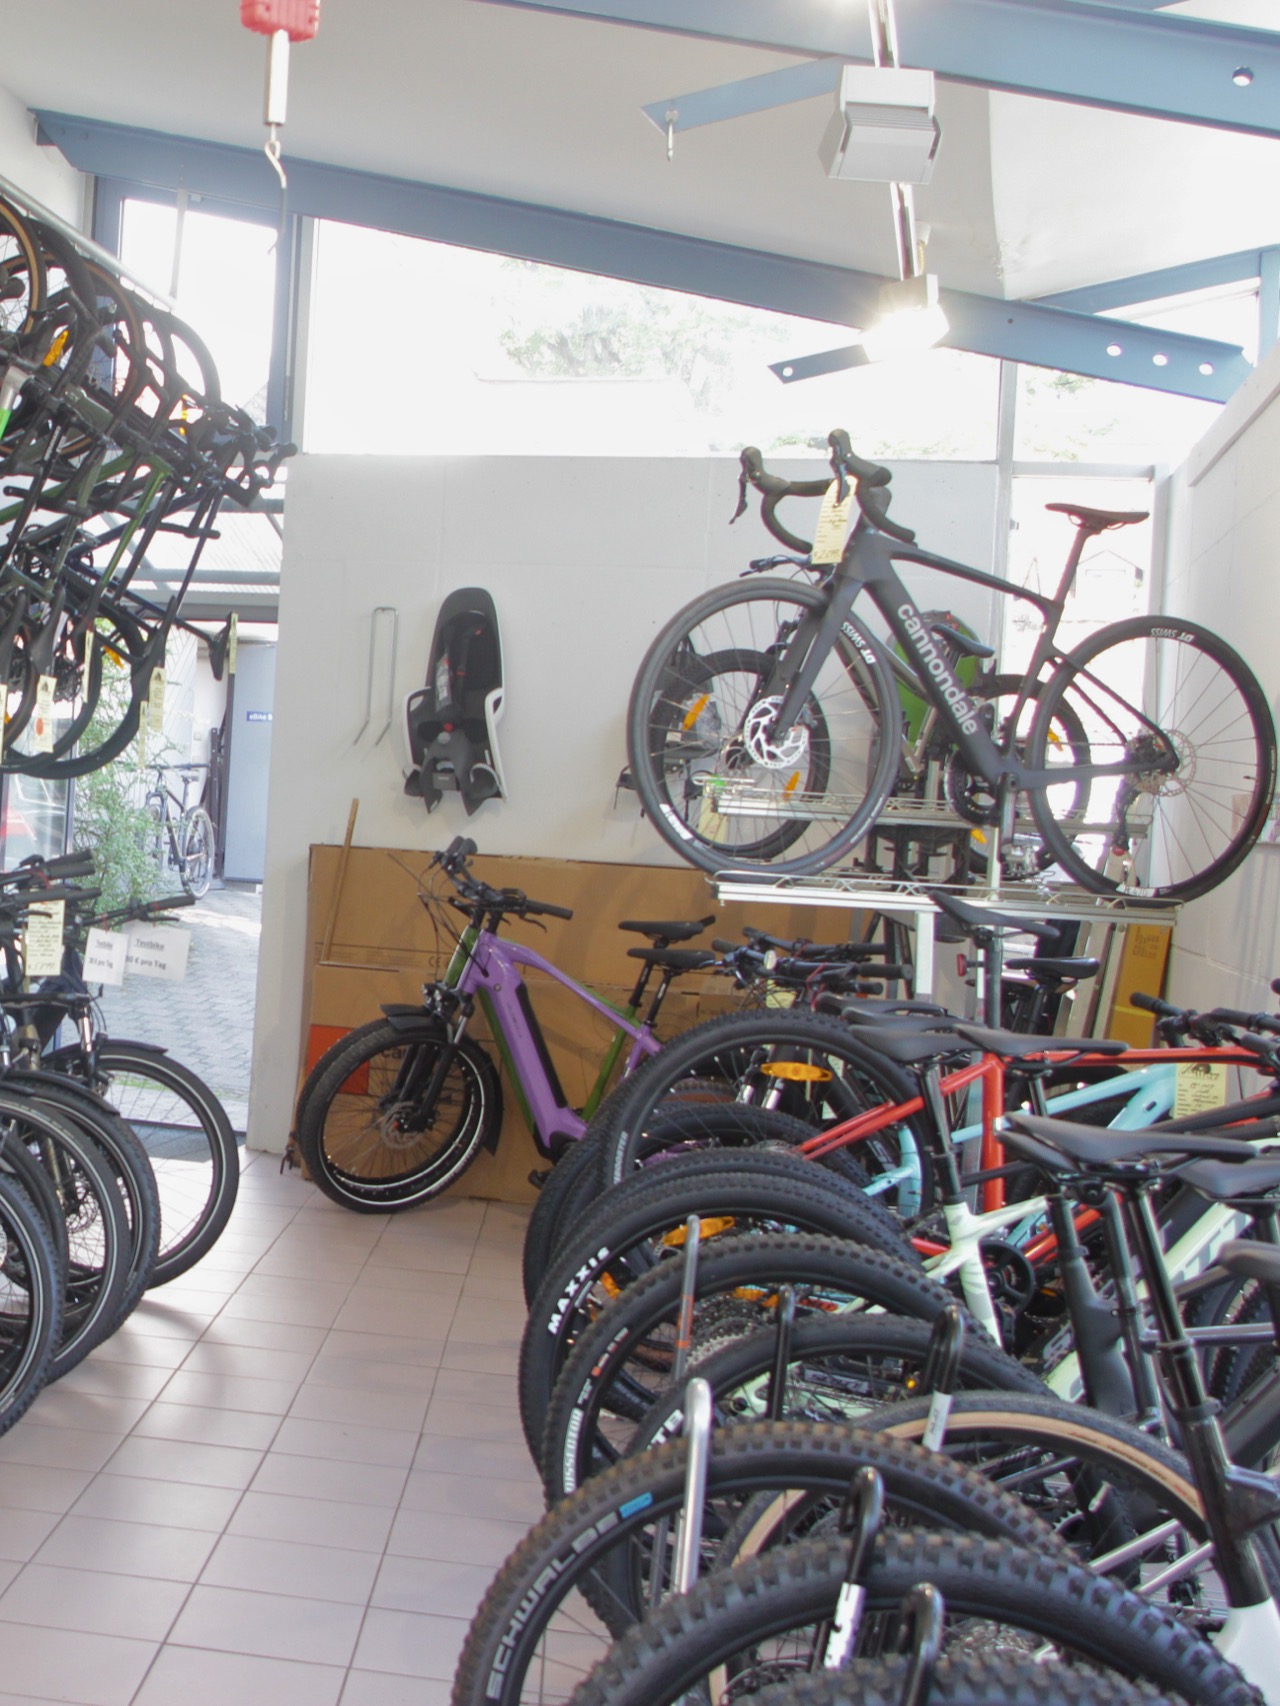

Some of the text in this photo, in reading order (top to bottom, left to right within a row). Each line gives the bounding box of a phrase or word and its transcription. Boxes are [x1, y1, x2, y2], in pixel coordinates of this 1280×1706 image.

[839, 620, 877, 666] DT SWISS
[1150, 627, 1195, 643] DT SWISS
[897, 603, 979, 736] cannondale
[136, 938, 166, 951] Testbike
[141, 959, 152, 967] pro
[154, 960, 167, 970] Tag
[547, 1246, 610, 1335] MAXXIS
[485, 1511, 620, 1700] SCHWALBE
